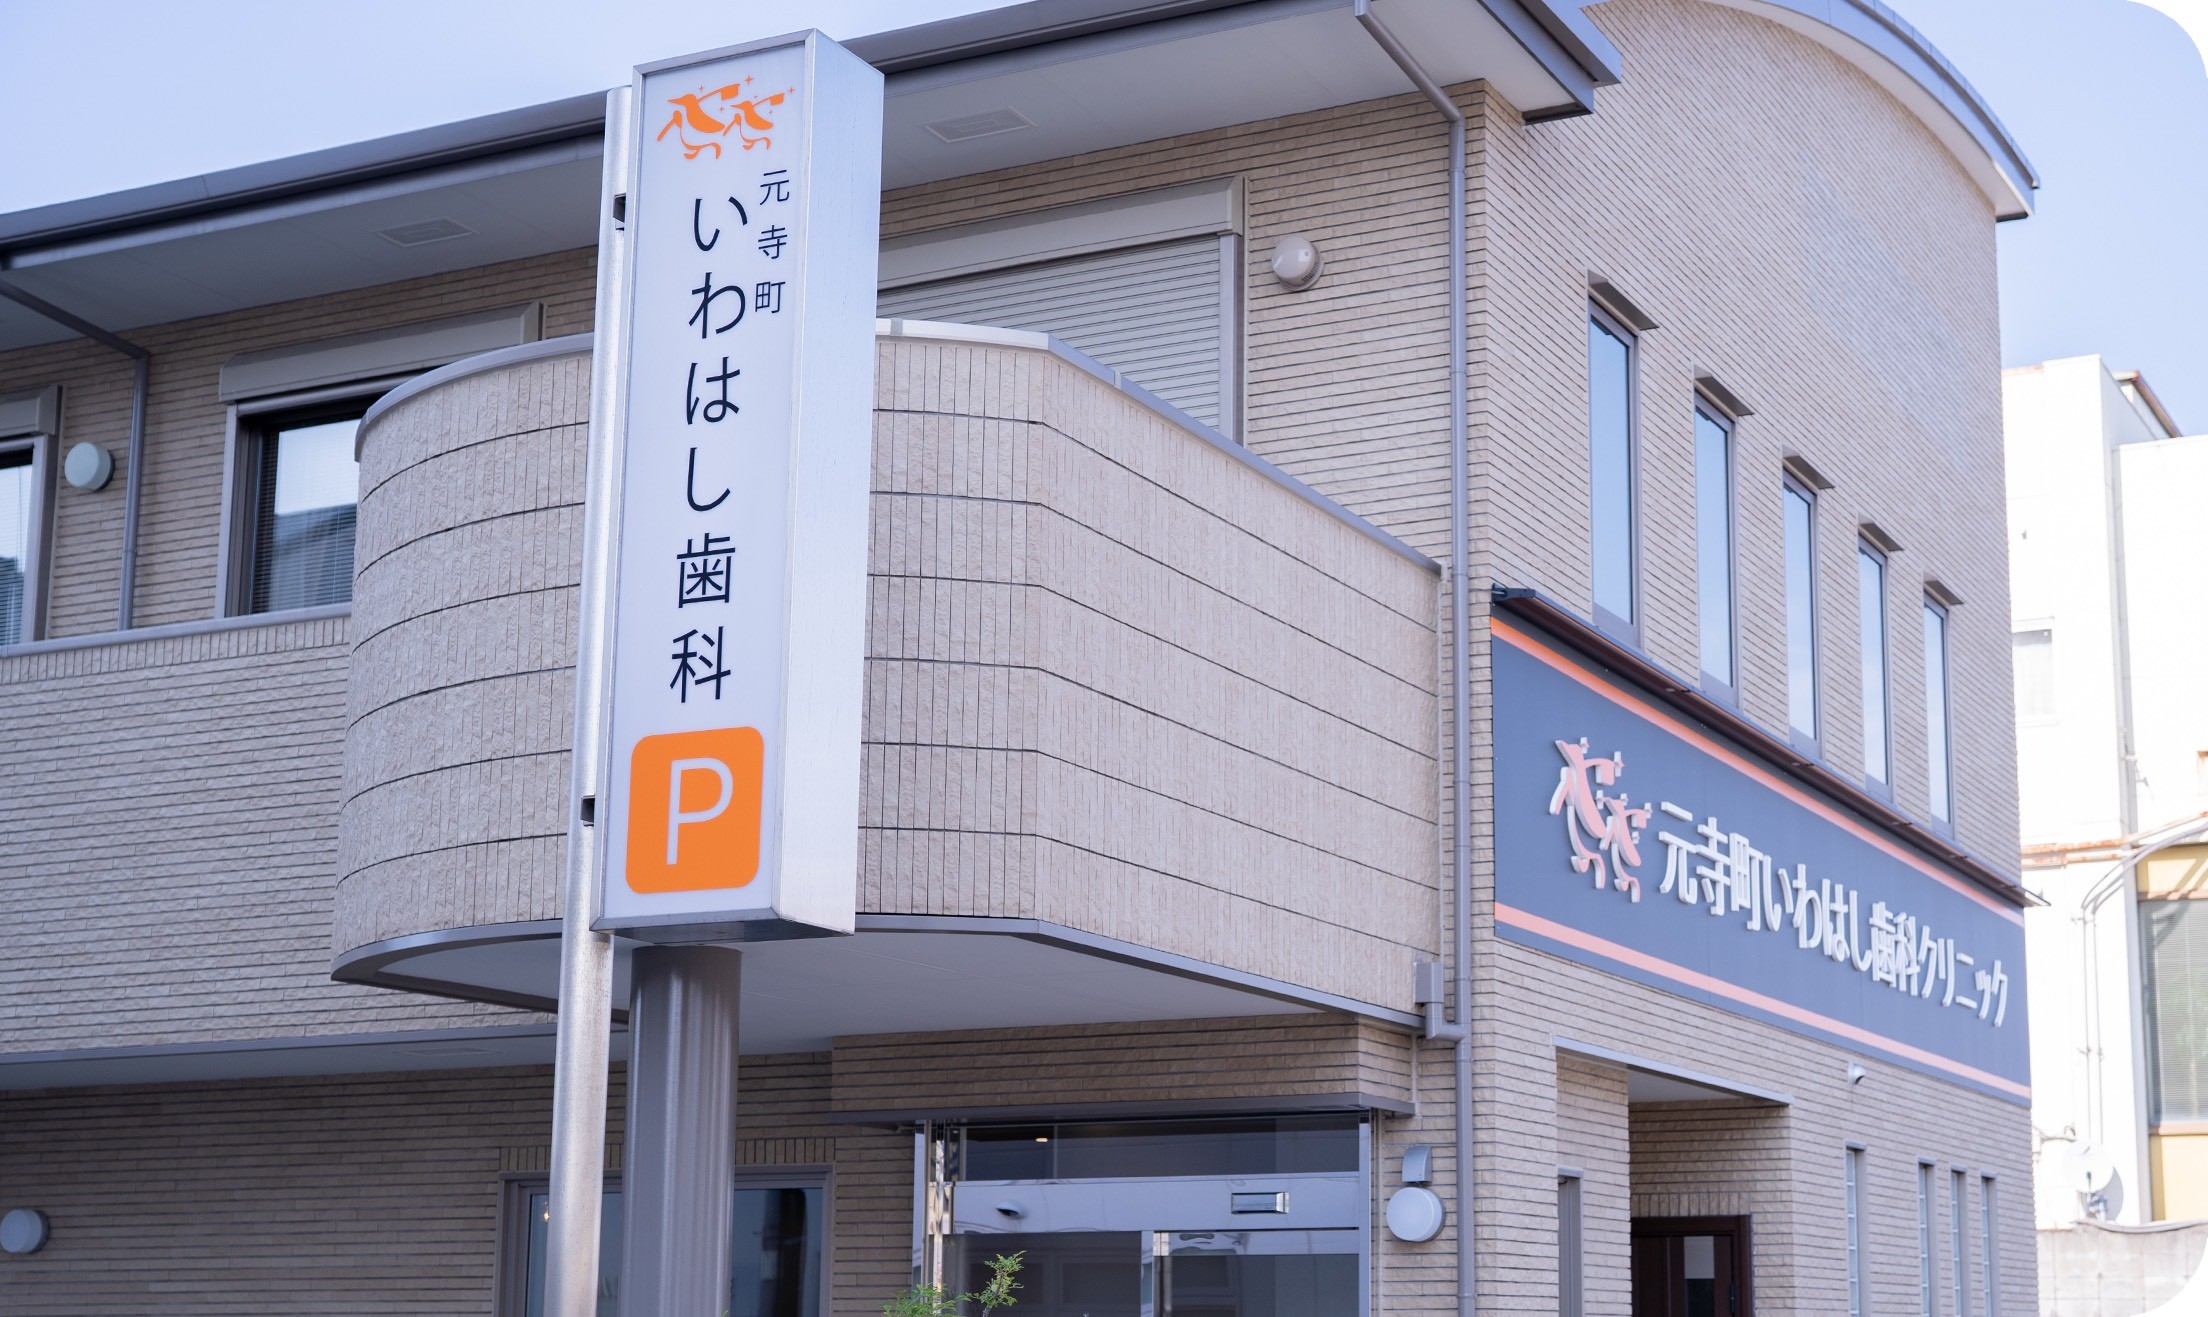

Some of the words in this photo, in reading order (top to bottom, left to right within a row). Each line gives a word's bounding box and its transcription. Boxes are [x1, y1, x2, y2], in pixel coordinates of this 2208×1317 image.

[755, 169, 790, 314] 元寺町
[670, 196, 748, 704] いわはし歯科
[666, 757, 733, 865] P
[1659, 801, 2008, 1027] 元寺町いわはし歯科クリニック
